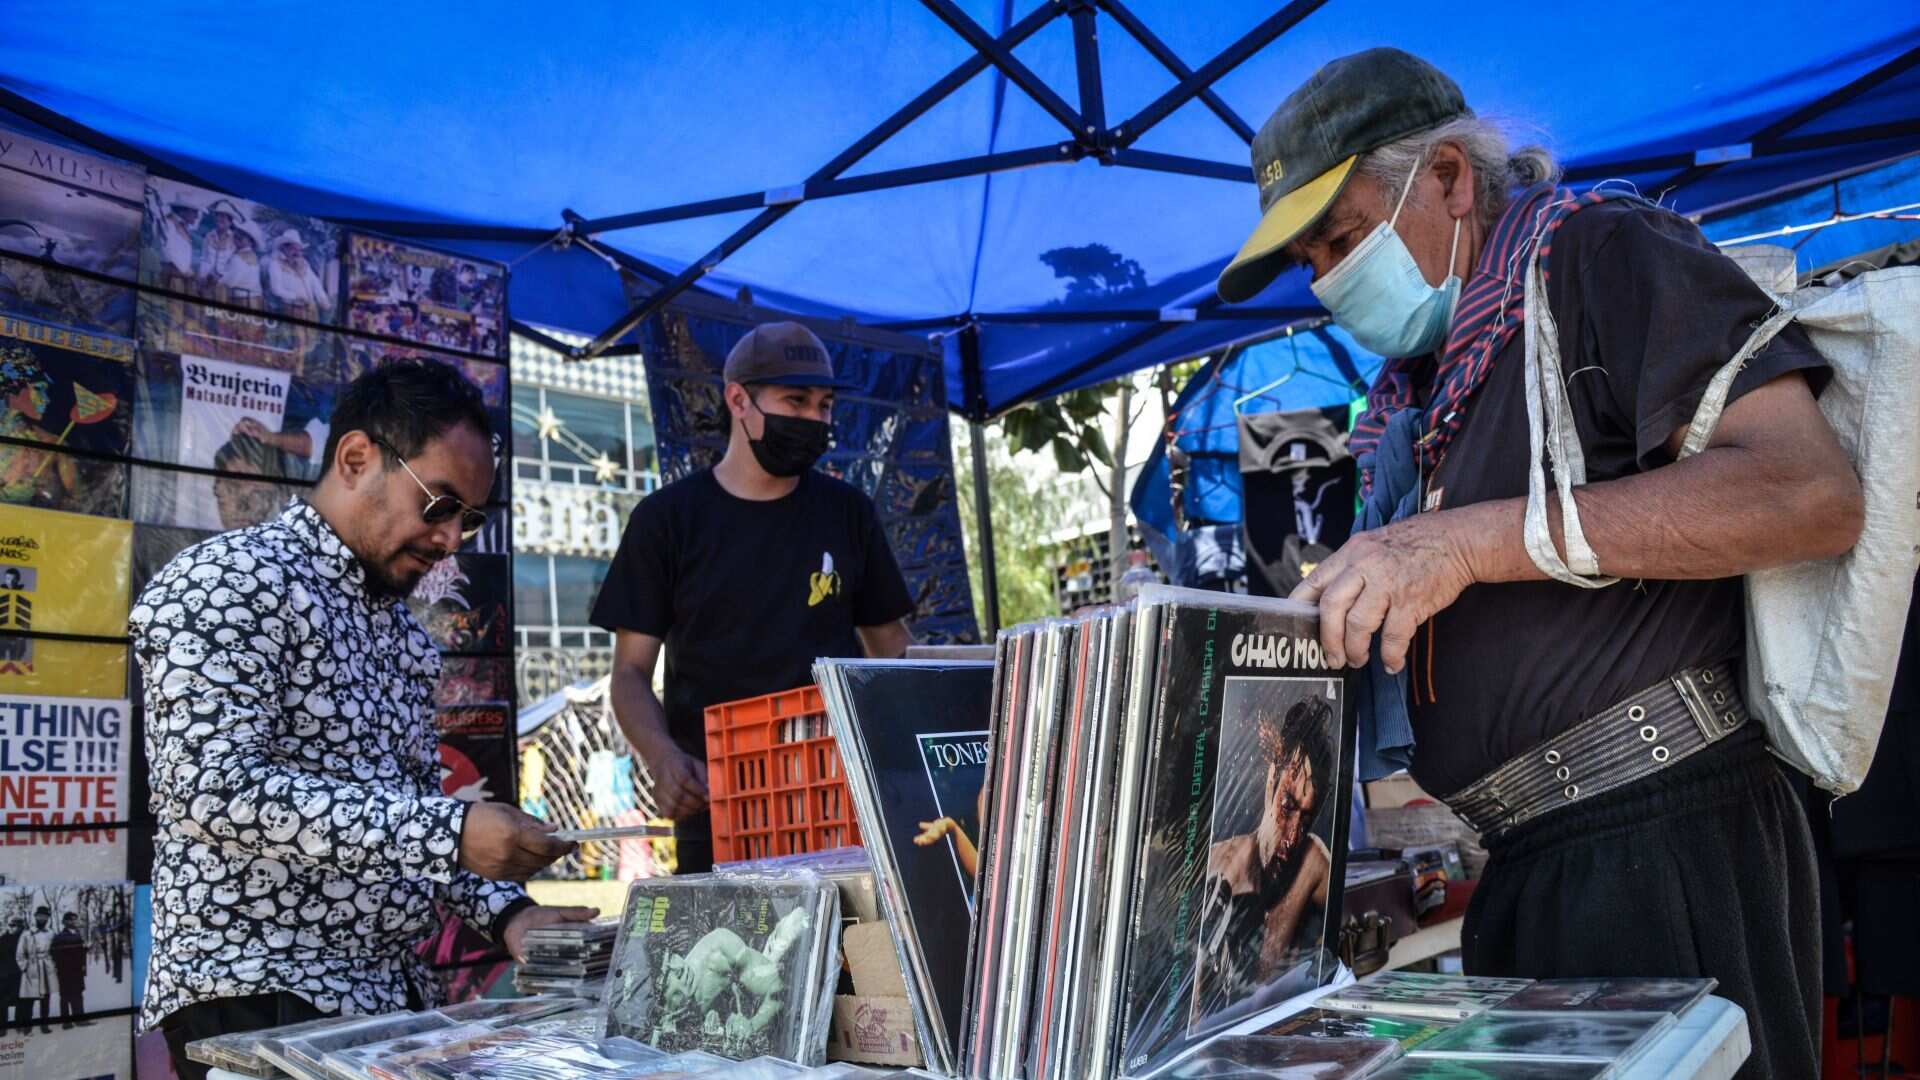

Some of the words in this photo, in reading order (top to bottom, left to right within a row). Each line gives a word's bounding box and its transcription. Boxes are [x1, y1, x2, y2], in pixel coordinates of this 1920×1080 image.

[30, 149, 123, 191] MUSIC
[186, 364, 283, 399] Brujeria
[1231, 633, 1291, 668] CHAC
[649, 896, 670, 934] pop
